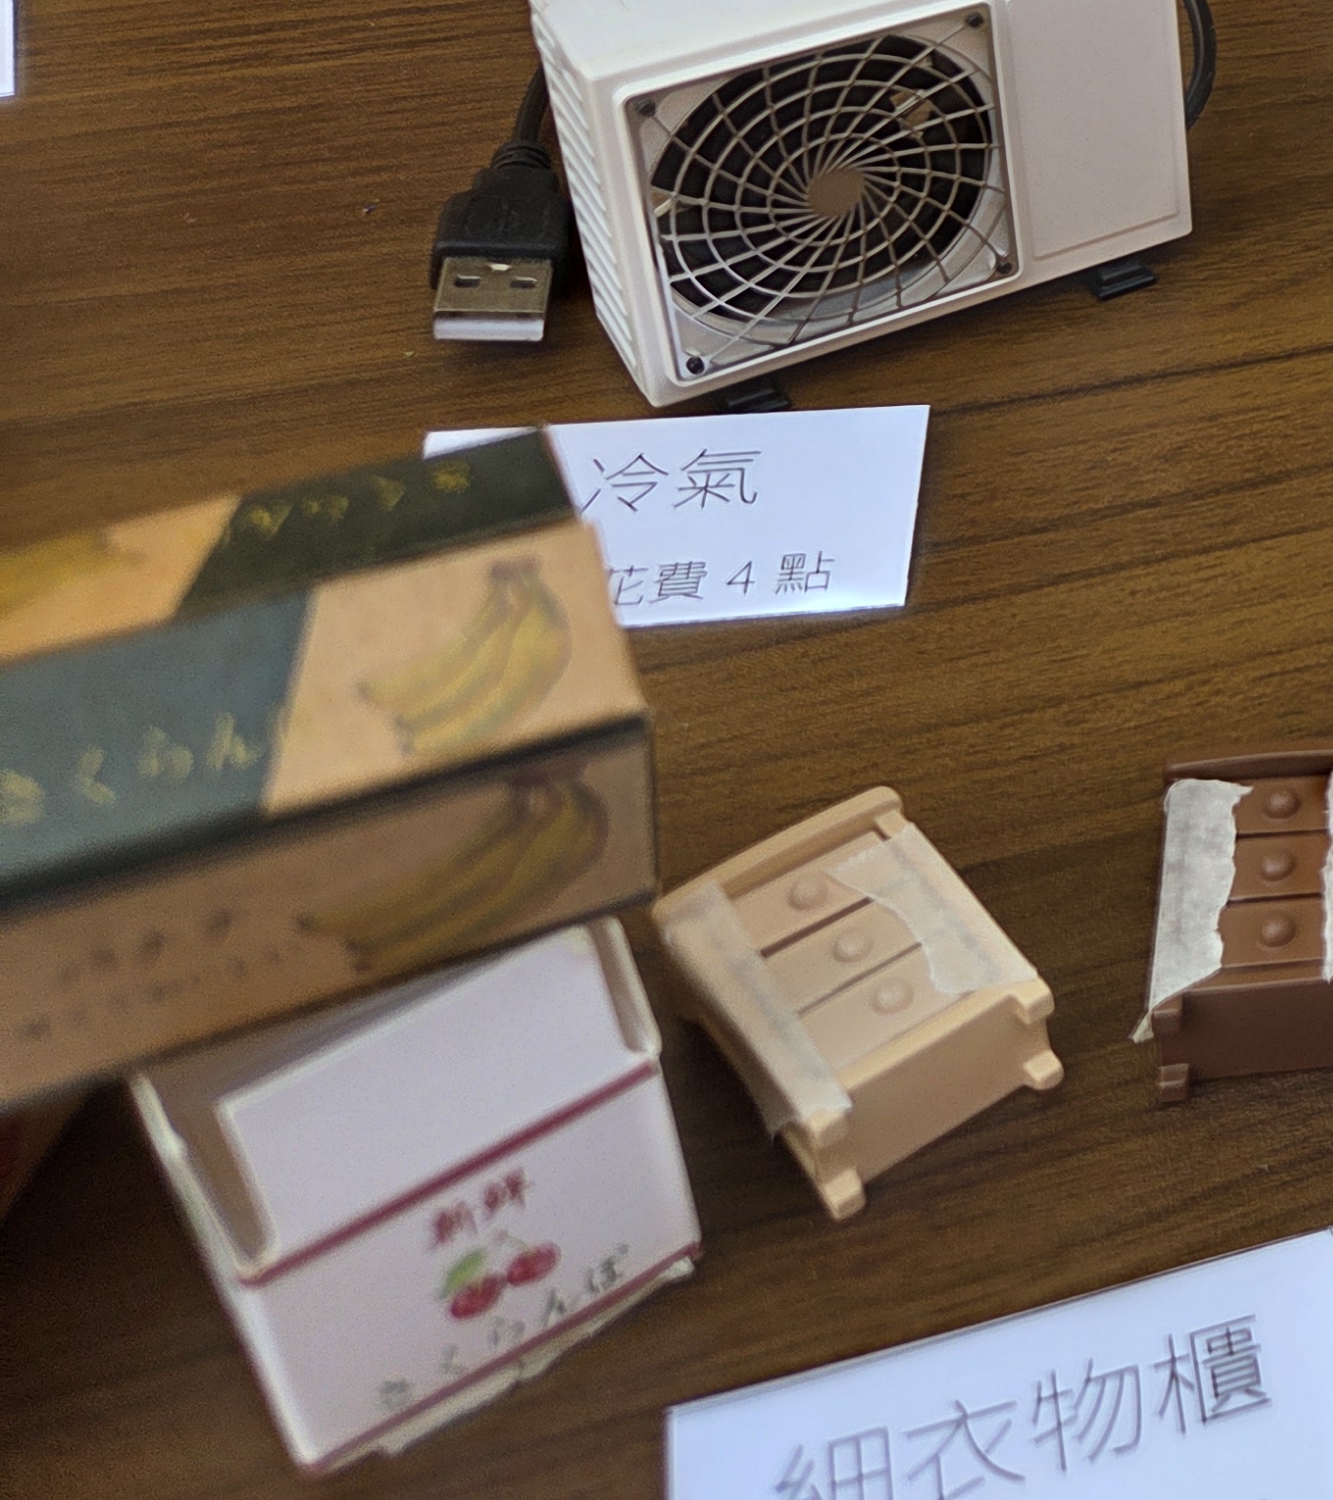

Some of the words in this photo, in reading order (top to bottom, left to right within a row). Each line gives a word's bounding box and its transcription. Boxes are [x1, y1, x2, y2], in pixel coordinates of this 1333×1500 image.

[580, 448, 762, 513] 冷氣
[726, 560, 756, 594] 4
[774, 550, 836, 595] 點
[775, 1314, 1273, 1500] 細衣物櫃
